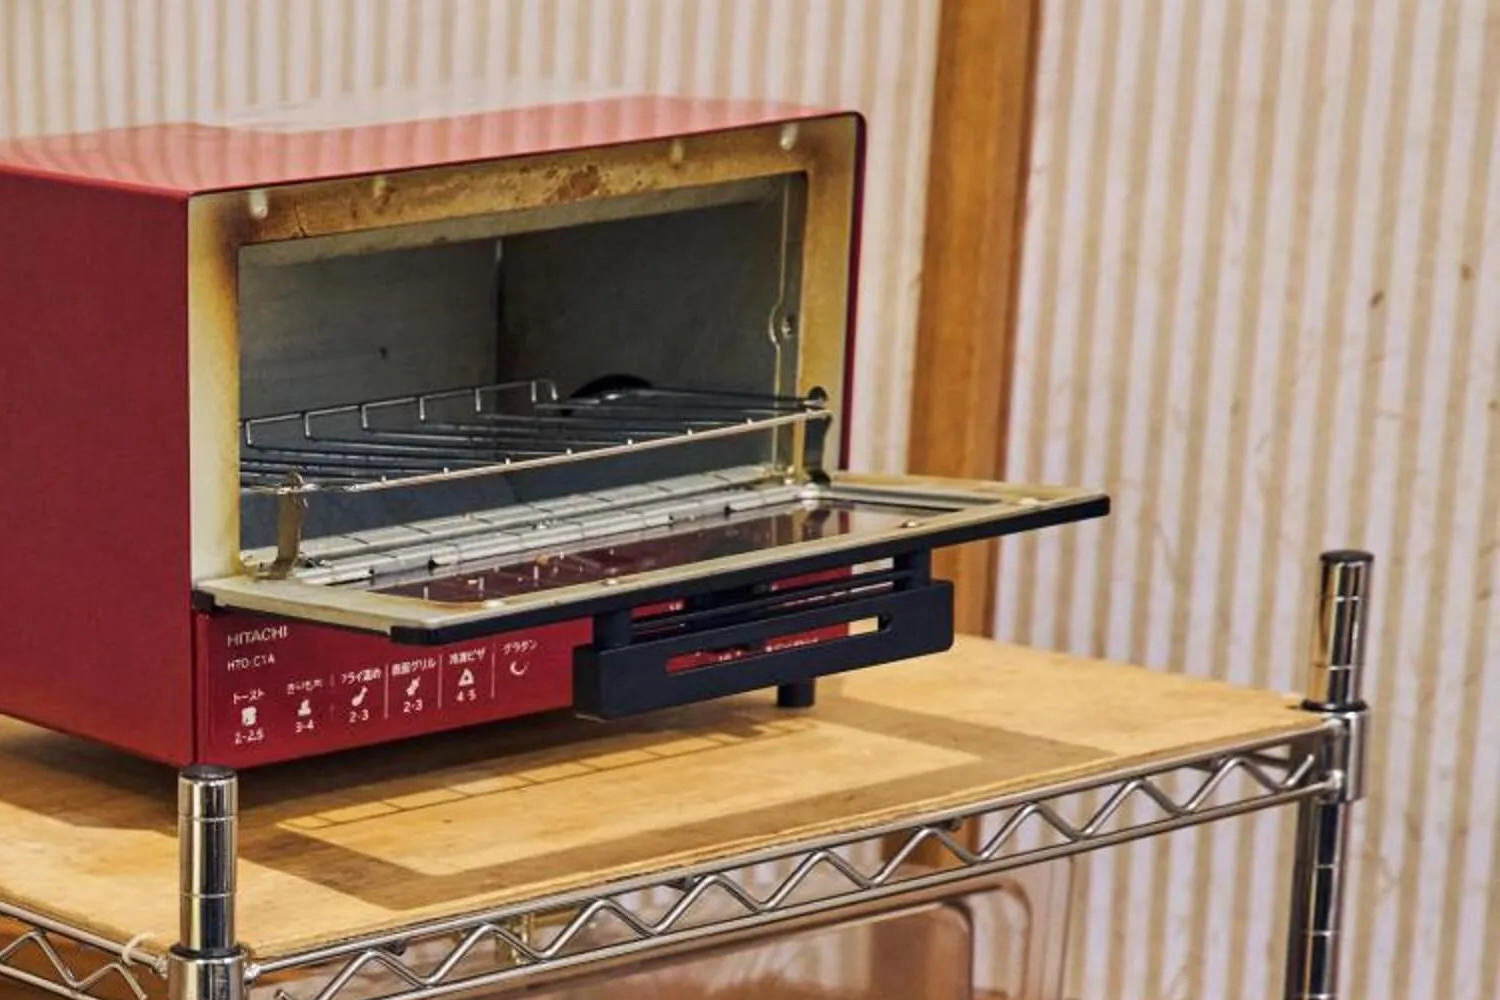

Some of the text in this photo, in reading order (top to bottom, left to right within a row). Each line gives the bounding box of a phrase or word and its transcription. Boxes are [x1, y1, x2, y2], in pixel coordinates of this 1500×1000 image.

[227, 624, 288, 647] HITACHI
[233, 688, 266, 705] トースト
